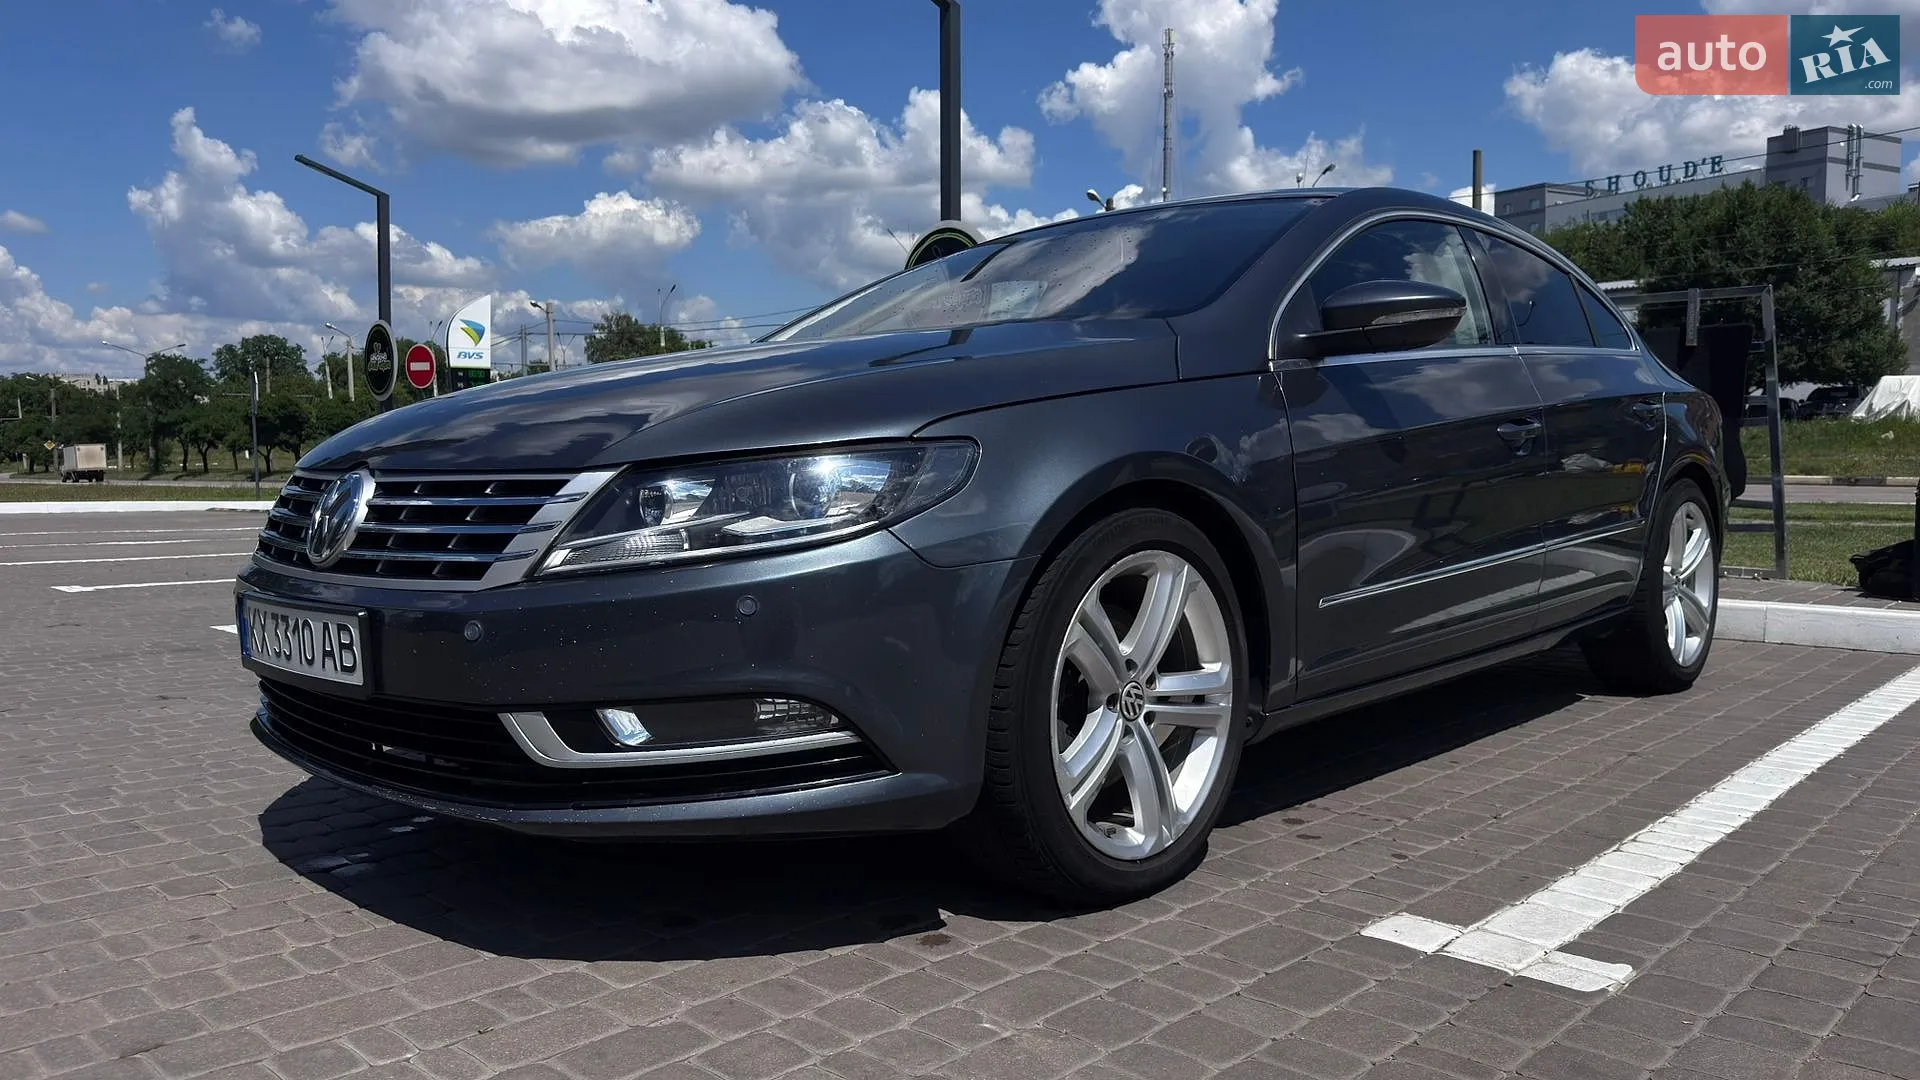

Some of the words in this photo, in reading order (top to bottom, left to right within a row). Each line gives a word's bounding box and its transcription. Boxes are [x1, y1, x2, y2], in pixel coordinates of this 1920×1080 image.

[456, 350, 484, 360] BVS
[270, 611, 316, 666] 3310
[321, 620, 358, 674] AB
